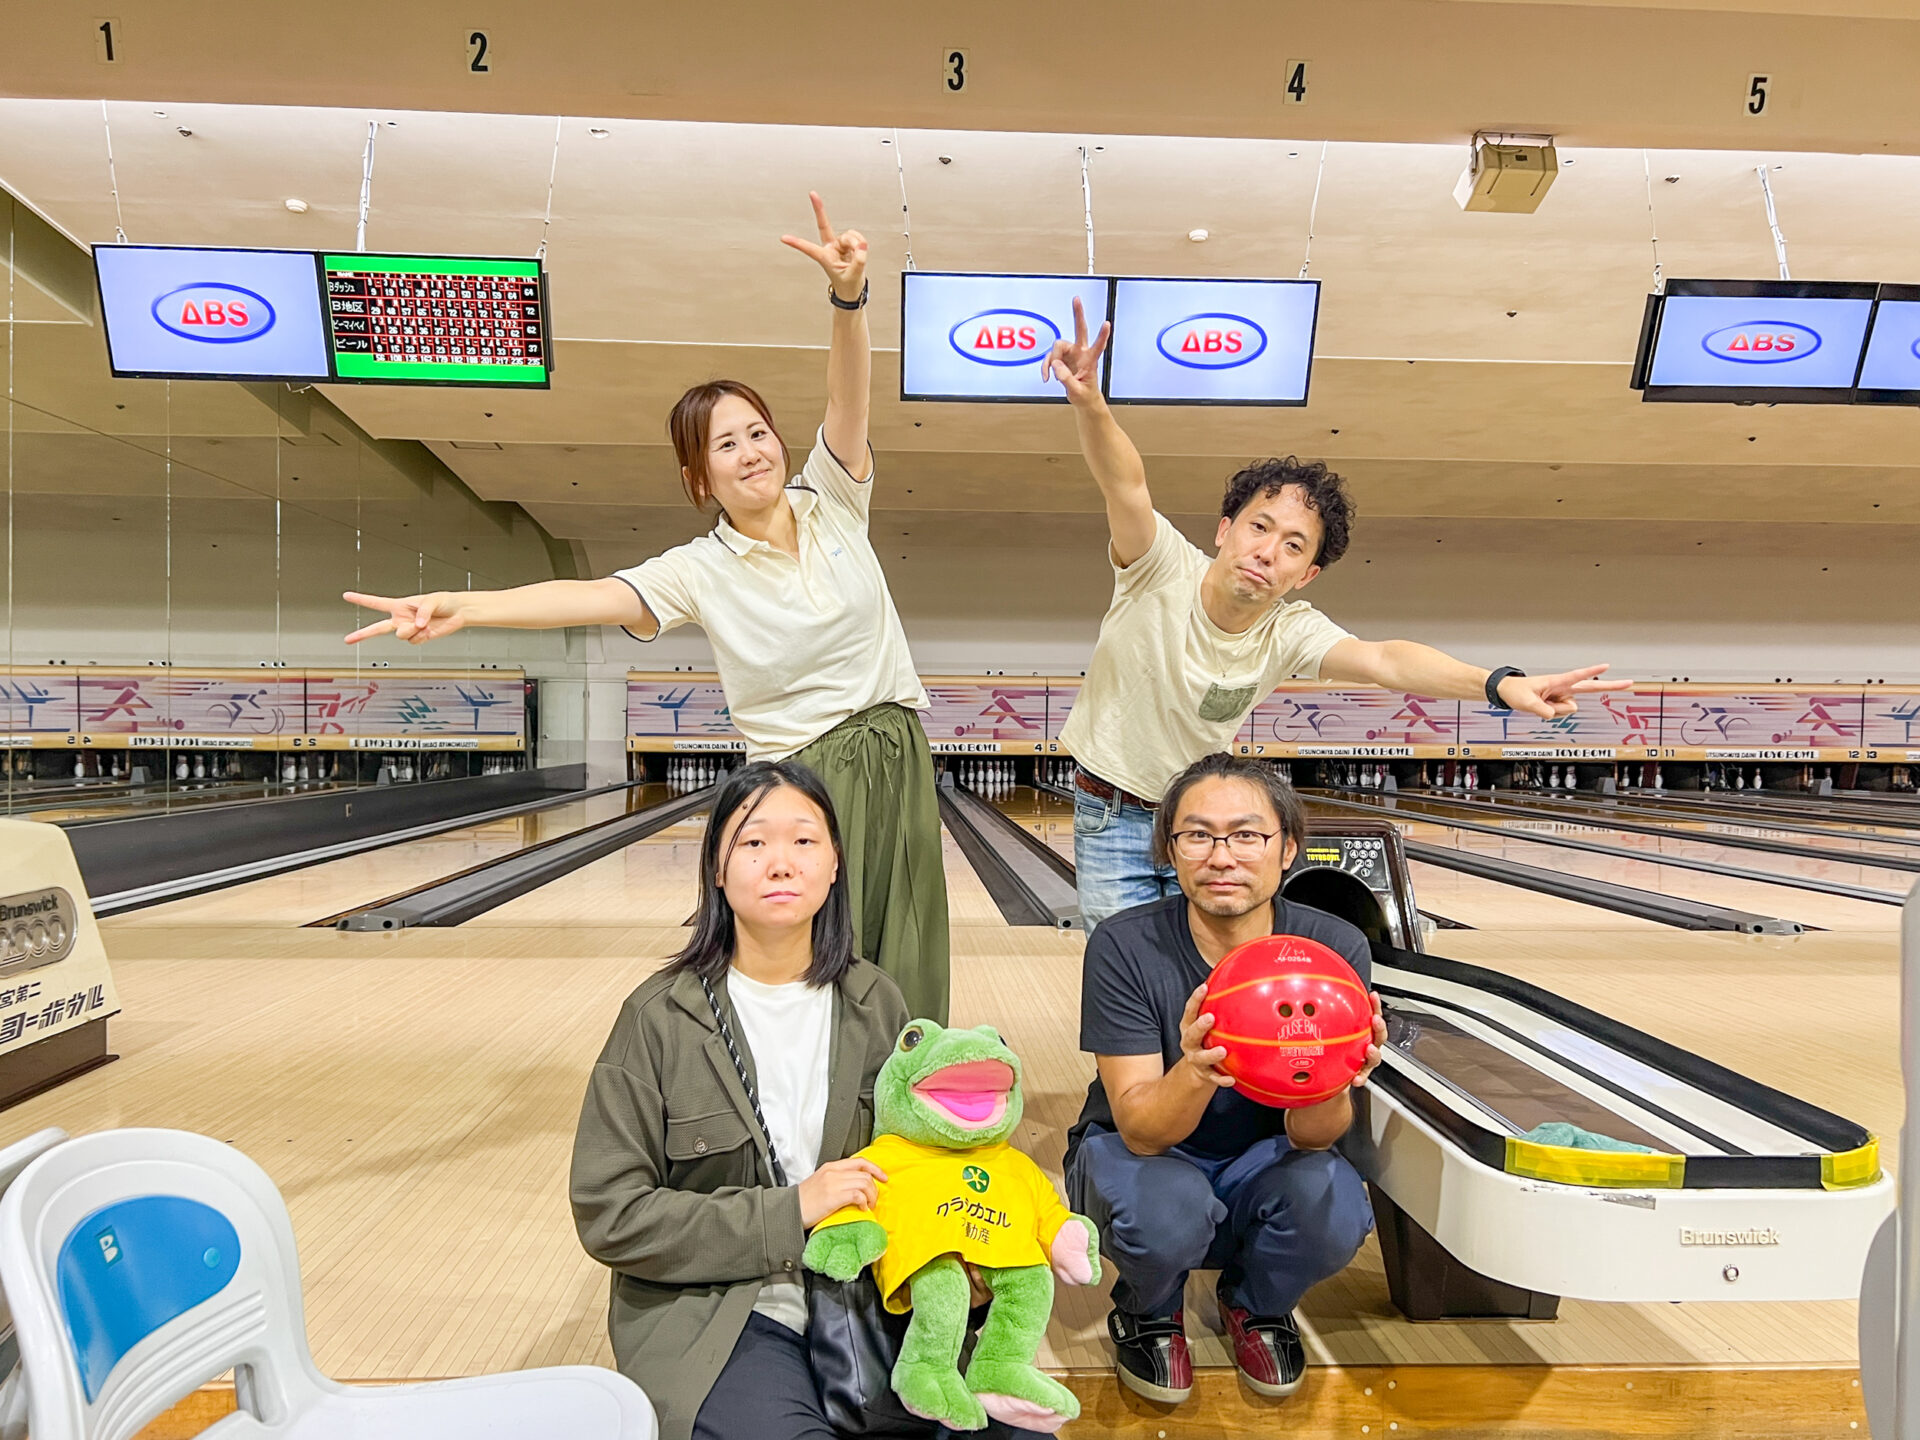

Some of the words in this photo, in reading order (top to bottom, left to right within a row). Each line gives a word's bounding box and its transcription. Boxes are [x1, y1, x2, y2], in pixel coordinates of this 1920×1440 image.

[99, 22, 113, 60] 1
[470, 32, 488, 72] 2
[947, 52, 965, 91] 3
[1288, 63, 1306, 102] 4
[1749, 77, 1767, 115] 5
[974, 327, 1037, 351] ABS
[1181, 331, 1243, 354] ABS
[1726, 334, 1796, 353] ABS
[1034, 743, 1042, 752] 4
[1049, 743, 1058, 752] 5
[1241, 745, 1249, 754] 6
[1256, 746, 1264, 754] 7
[1447, 747, 1455, 756] 8
[1462, 747, 1470, 756] 9
[1646, 749, 1658, 757] 10
[1665, 749, 1675, 757] 11
[1848, 750, 1860, 759] 12
[1866, 750, 1877, 759] 13
[1680, 1226, 1780, 1245] Brunswick
